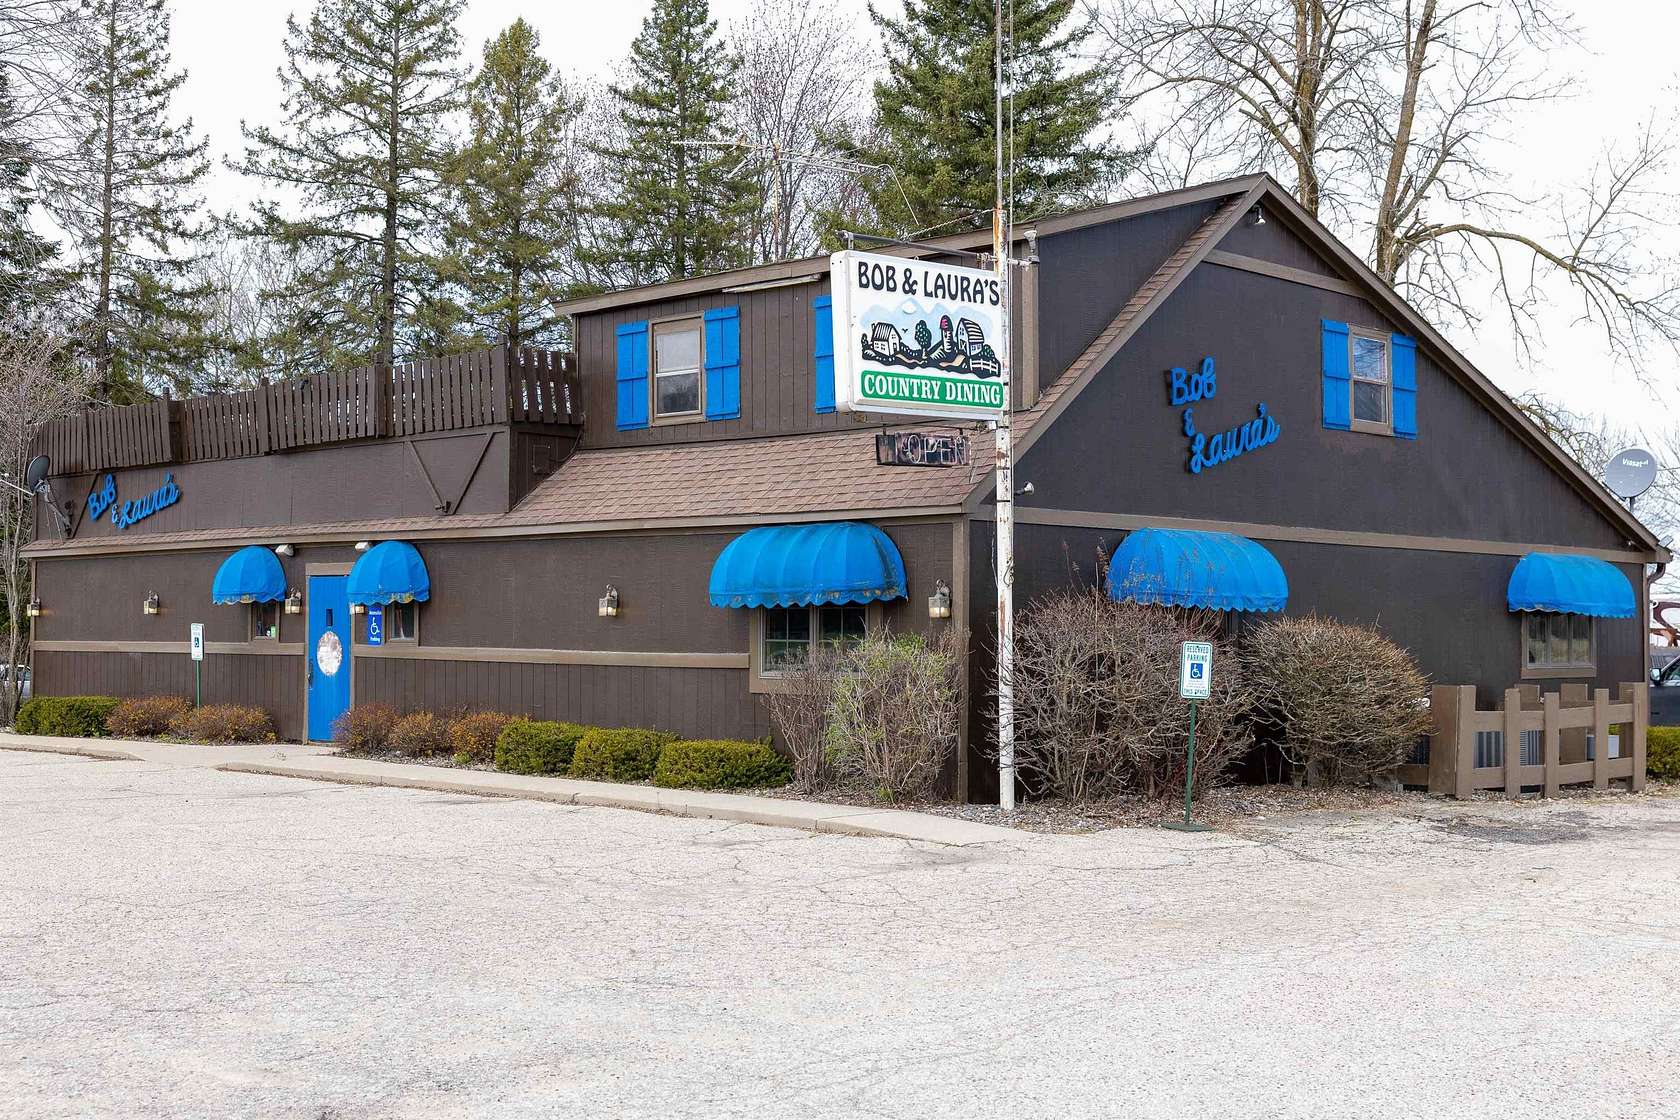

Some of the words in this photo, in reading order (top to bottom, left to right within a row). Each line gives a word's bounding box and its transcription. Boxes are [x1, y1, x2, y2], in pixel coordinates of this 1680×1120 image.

[858, 261, 897, 292] BOB
[902, 267, 918, 295] &
[923, 271, 1000, 306] LAURA'S
[863, 374, 941, 400] COUNTRY
[945, 382, 1001, 405] DINING
[1170, 355, 1216, 406] Bob
[907, 434, 966, 465] OPEN
[1190, 402, 1281, 474] Laura's
[88, 473, 117, 522] Bob
[119, 471, 180, 530] Laura's
[1186, 645, 1209, 654] RESERVED
[1186, 654, 1208, 663] PARKING
